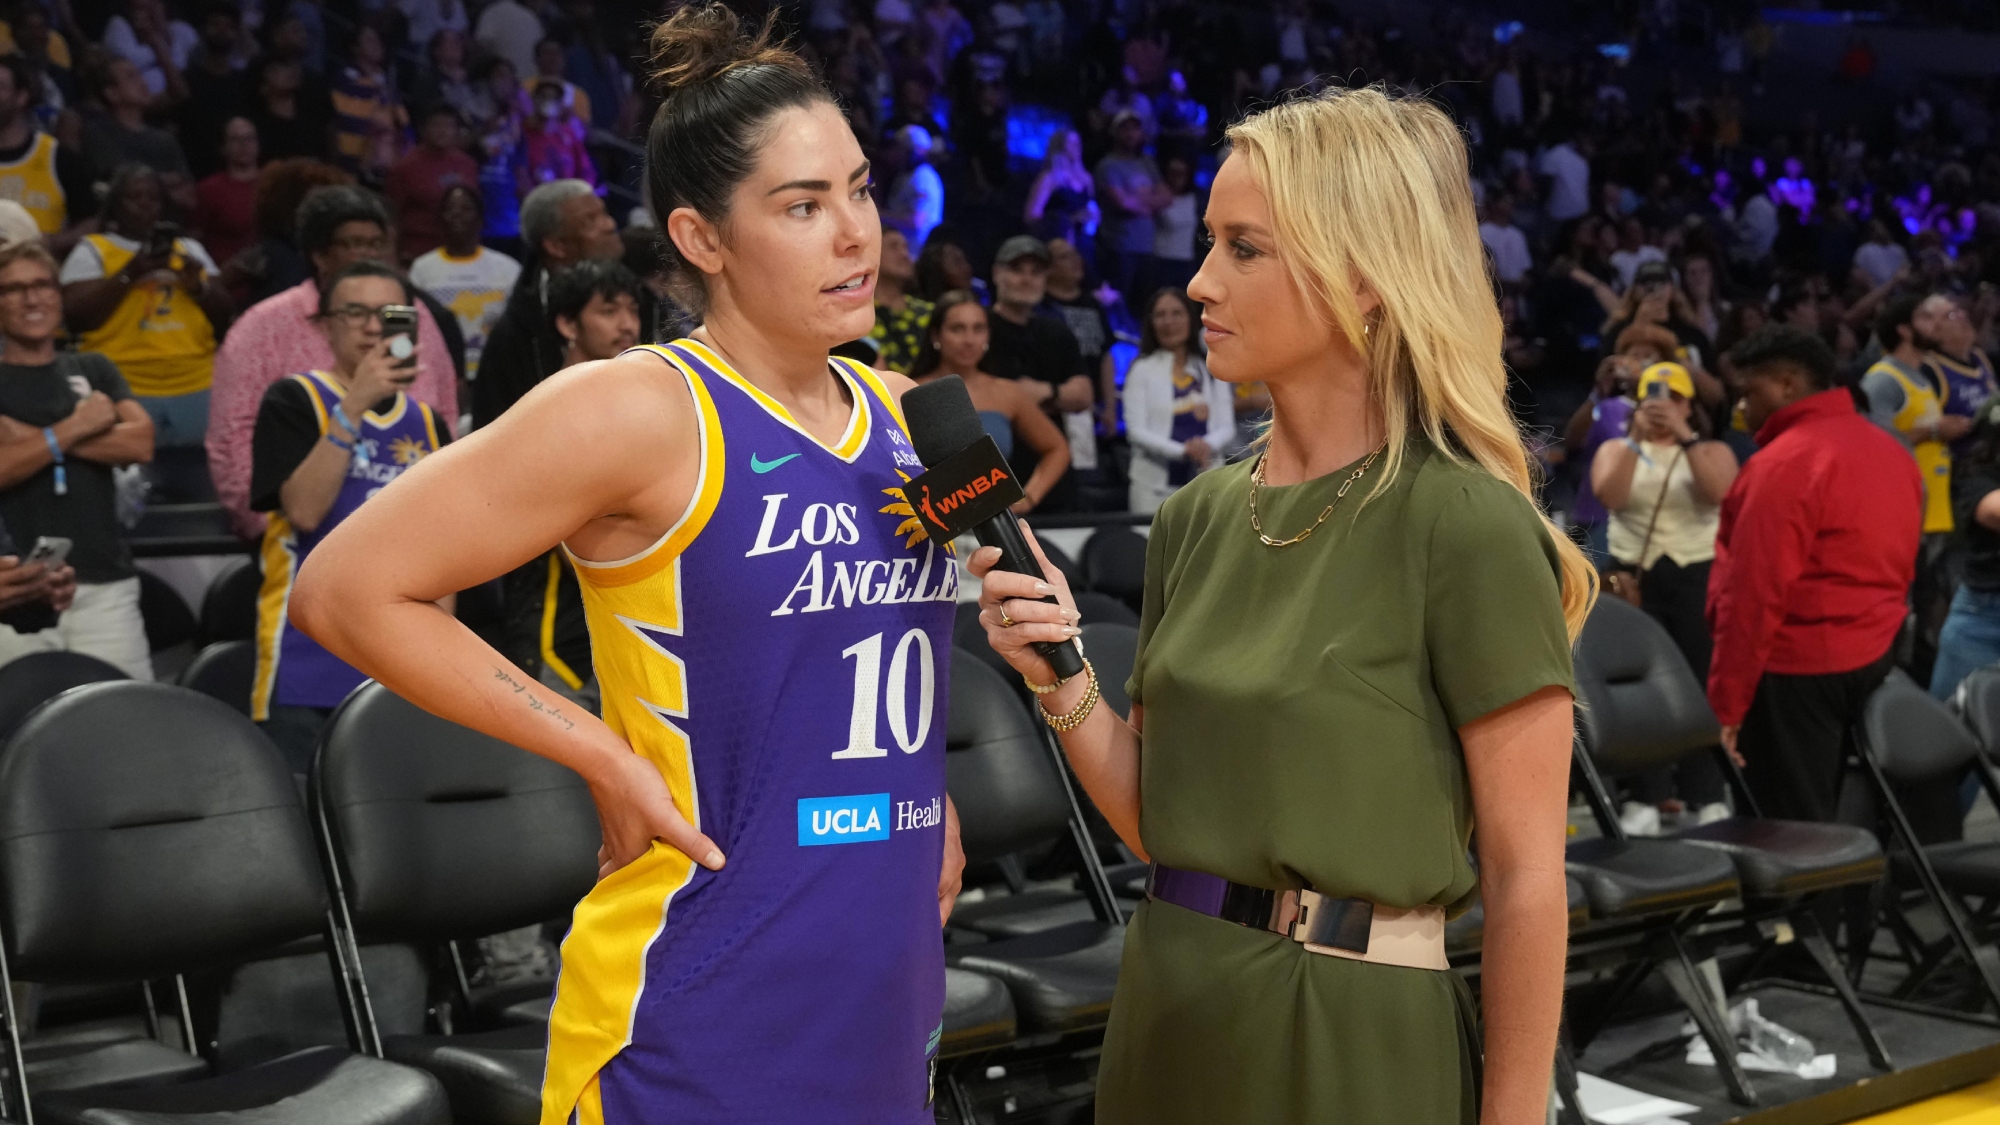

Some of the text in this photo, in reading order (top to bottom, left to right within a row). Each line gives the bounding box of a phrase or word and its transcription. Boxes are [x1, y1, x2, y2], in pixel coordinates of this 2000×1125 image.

[892, 450, 923, 467] Alber
[936, 467, 1009, 515] WNBA
[745, 493, 860, 558] LOS
[770, 537, 960, 617] ANGELE
[528, 693, 544, 712] the
[831, 628, 935, 760] 10
[812, 806, 881, 836] UCLA
